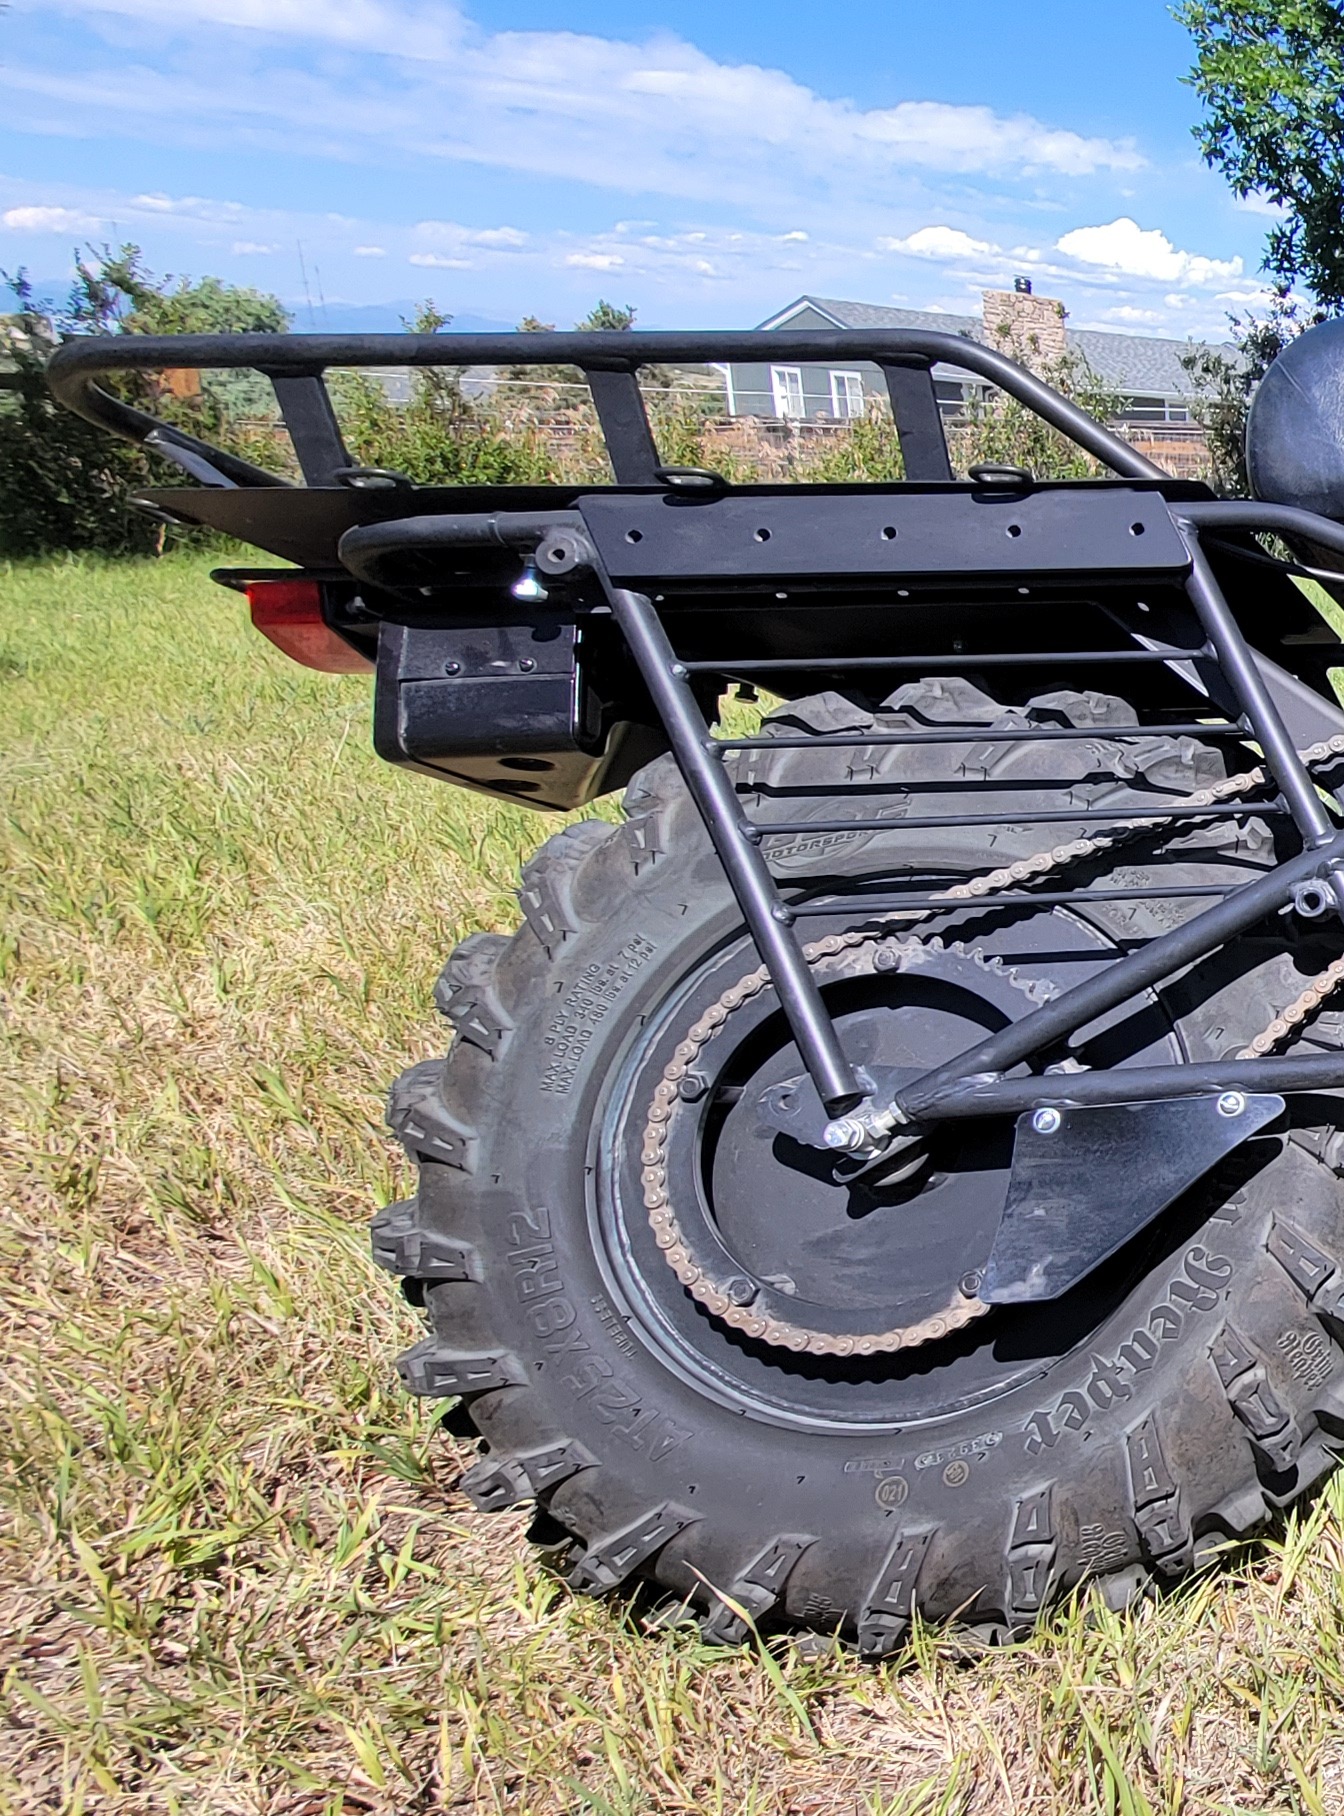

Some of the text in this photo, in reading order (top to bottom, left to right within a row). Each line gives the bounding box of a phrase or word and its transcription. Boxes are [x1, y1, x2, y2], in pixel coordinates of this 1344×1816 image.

[552, 1010, 569, 1034] PLY
[564, 963, 601, 1008] RATING
[554, 1024, 578, 1058] LOAD
[572, 1029, 594, 1062] LOAD
[628, 958, 643, 971] 12
[1024, 1245, 1232, 1456] Reaper
